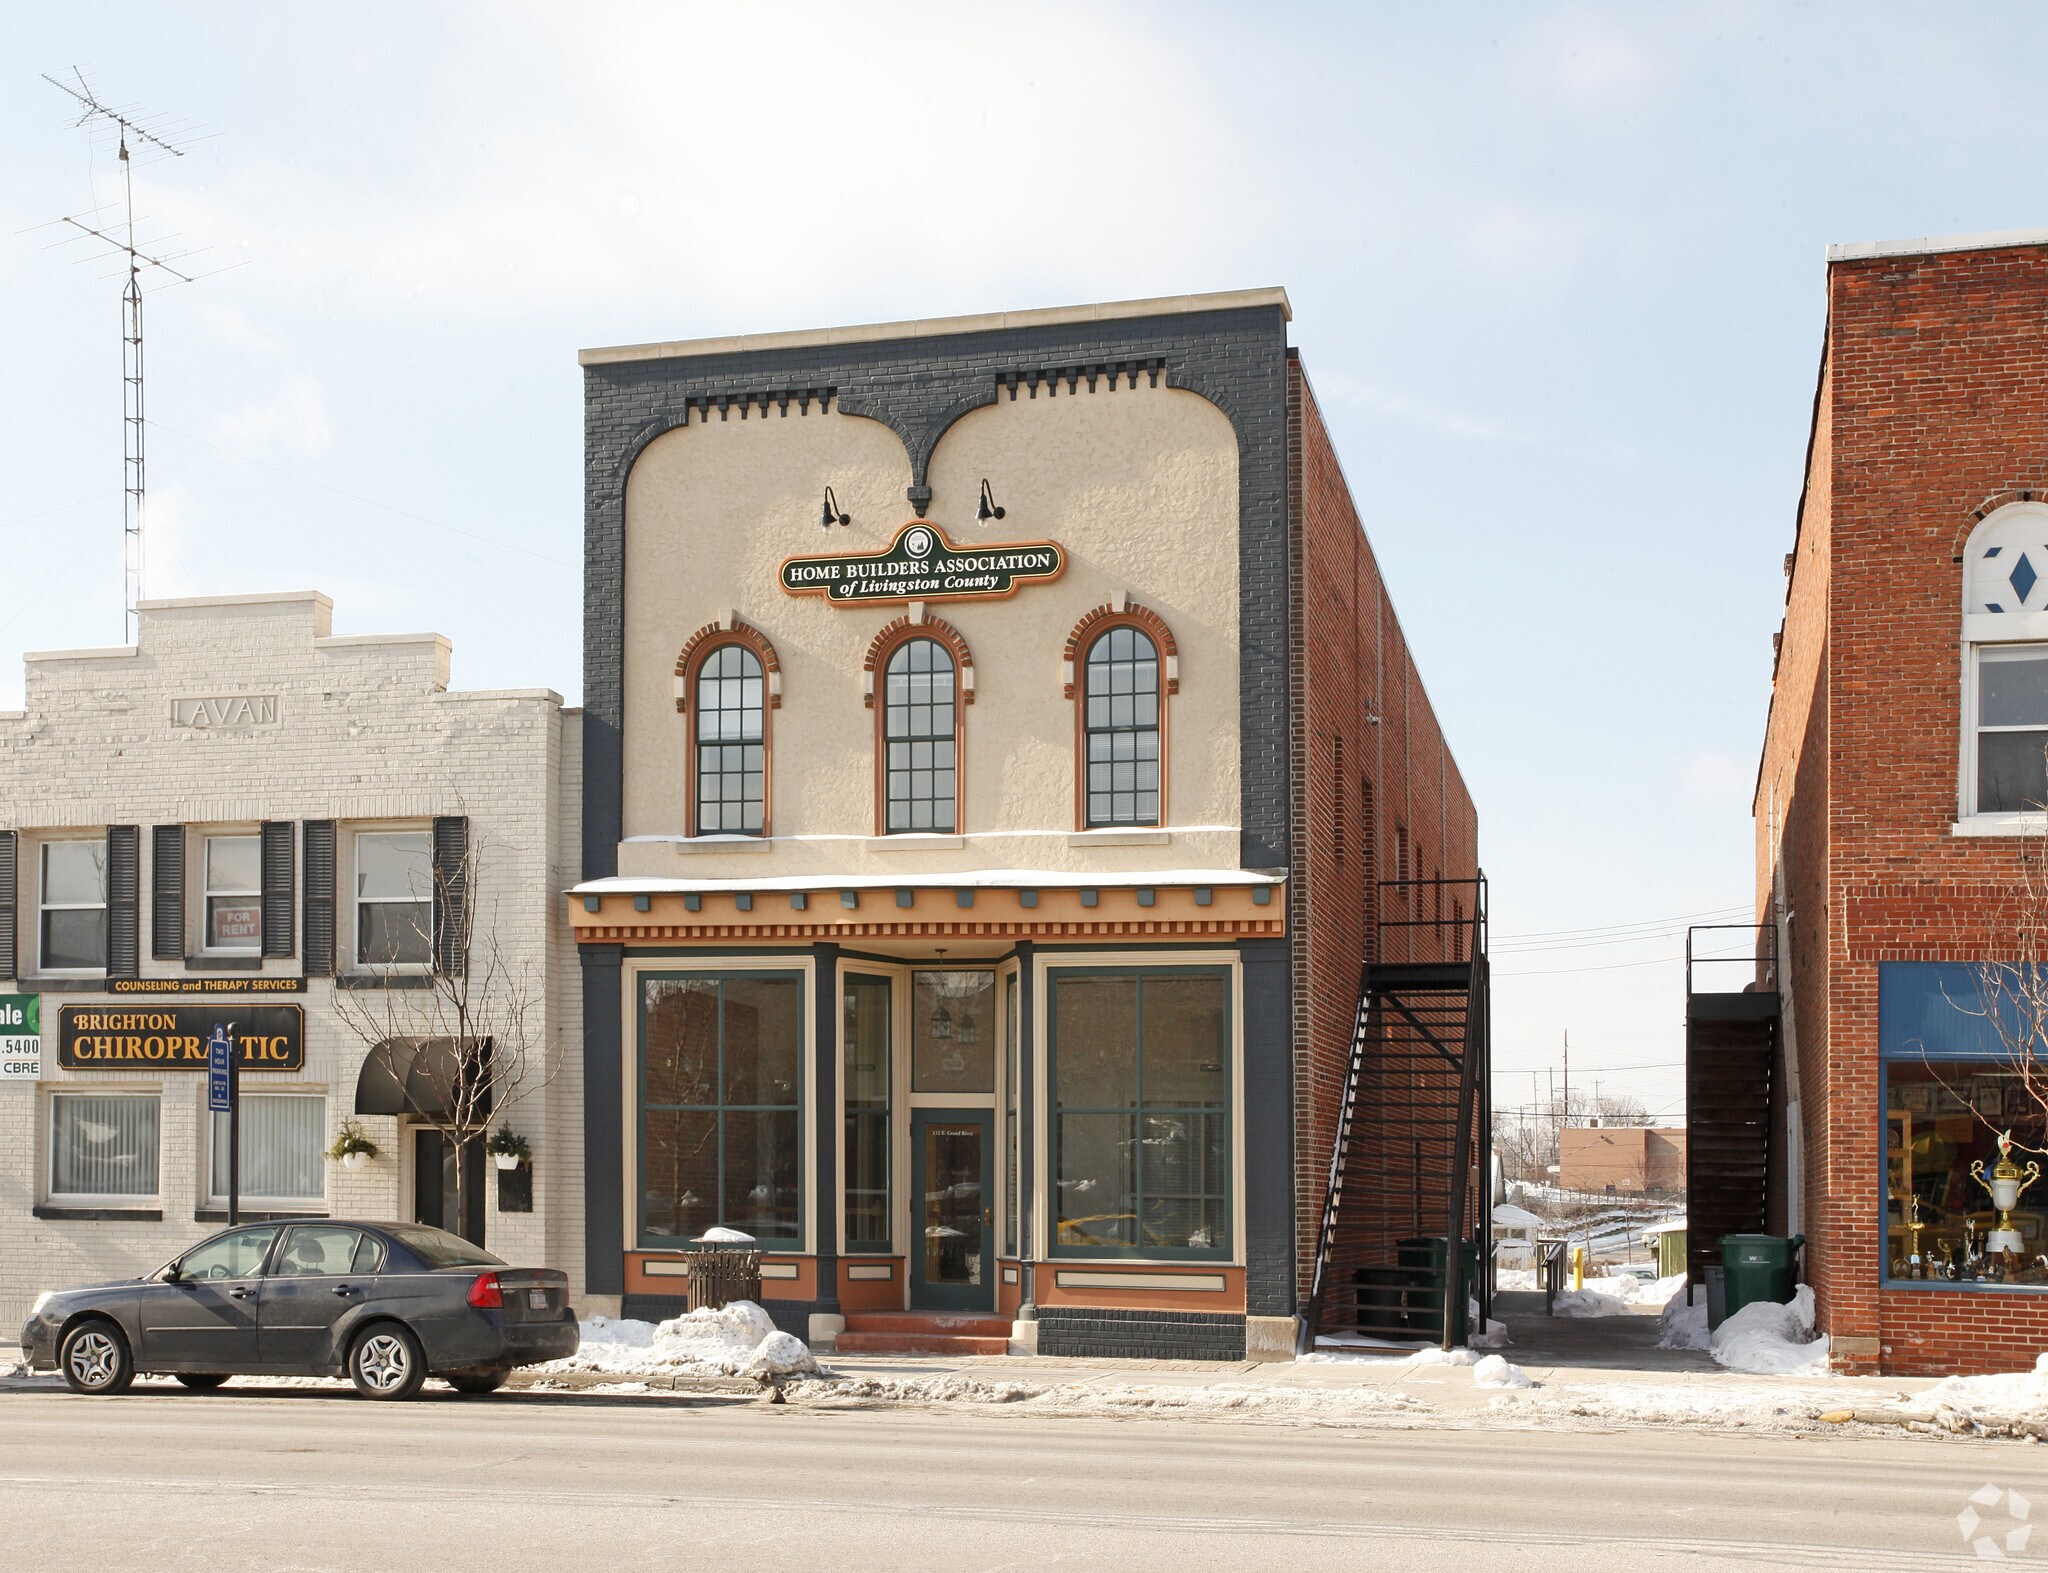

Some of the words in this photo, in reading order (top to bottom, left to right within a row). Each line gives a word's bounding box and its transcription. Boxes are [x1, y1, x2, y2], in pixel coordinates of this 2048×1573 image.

[790, 565, 841, 581] HOME
[846, 561, 929, 578] BUILDERS
[934, 553, 1051, 573] ASSOCIATION
[840, 580, 859, 597] of
[860, 578, 940, 595] Livingston
[944, 574, 999, 589] County
[227, 911, 250, 922] FOR
[222, 923, 256, 936] RENT
[115, 980, 180, 991] COUNSELING
[182, 980, 202, 991] and
[204, 980, 249, 991] THERAPY
[251, 979, 298, 990] SERVICES
[73, 1014, 177, 1030] BRIGHTON
[73, 1035, 290, 1060] CHIROPRTIC
[3, 1062, 39, 1074] CBRE
